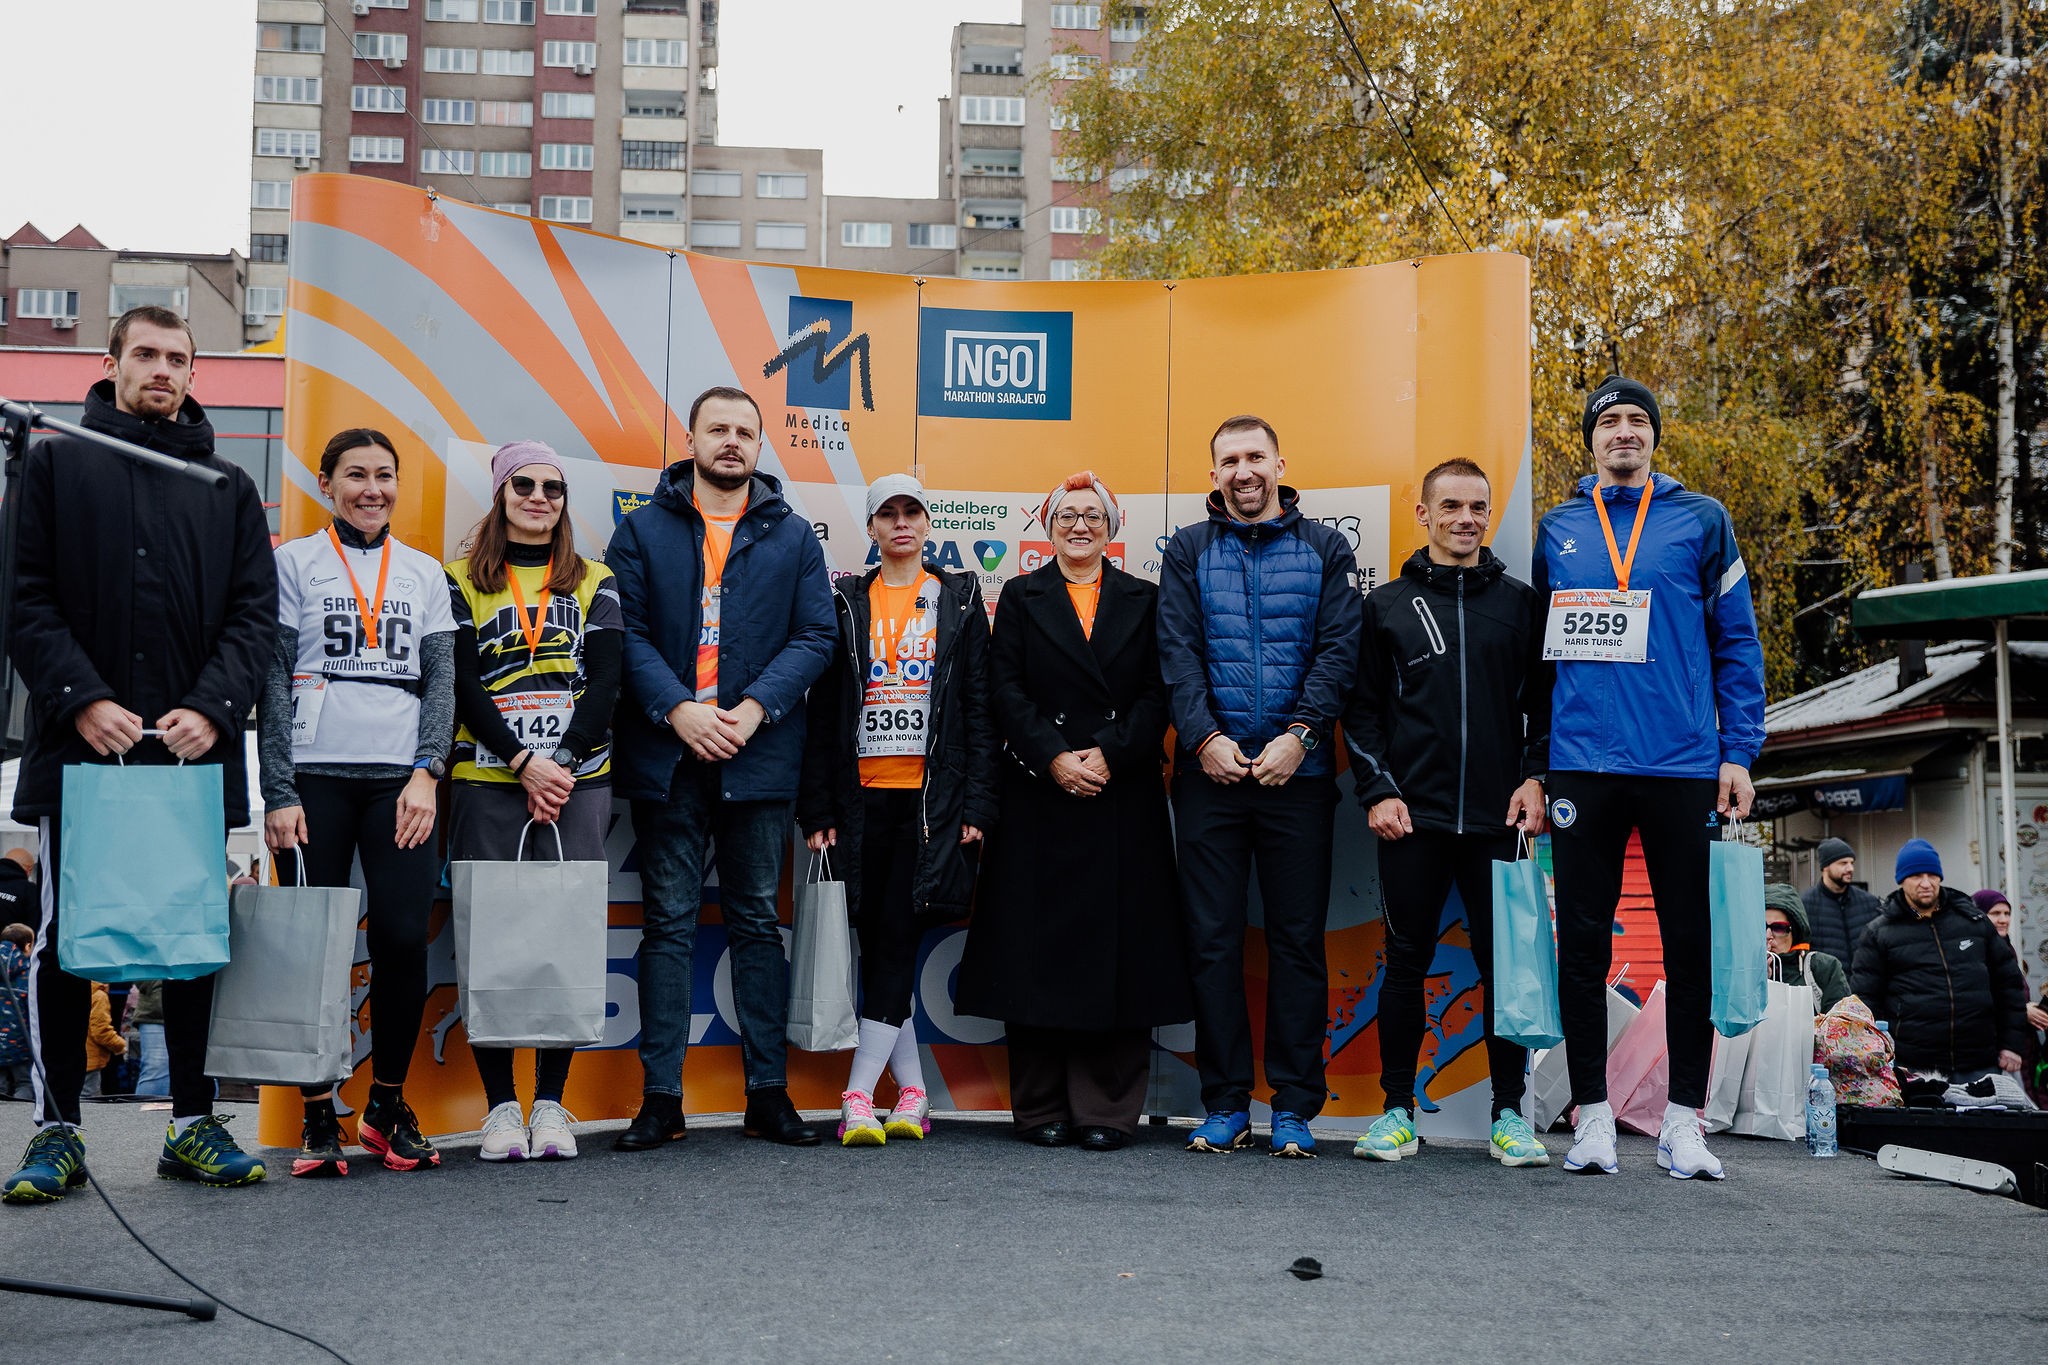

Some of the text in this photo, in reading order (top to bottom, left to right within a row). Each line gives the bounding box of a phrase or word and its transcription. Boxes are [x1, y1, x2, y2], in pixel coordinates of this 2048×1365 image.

[957, 343, 1034, 388] NGO
[943, 390, 1047, 405] MARATHON SARAJEVO
[785, 413, 851, 432] Medica
[790, 434, 845, 451] Zenica
[926, 500, 1008, 519] eidelberg
[930, 517, 996, 531] aterials
[323, 597, 412, 617] SAREVO
[1563, 612, 1628, 636] 5259
[1565, 638, 1589, 646] HARIS
[504, 715, 561, 738] 142
[865, 709, 924, 732] 5363
[895, 734, 923, 742] NOVAK
[1825, 789, 1863, 807] PEPSI
